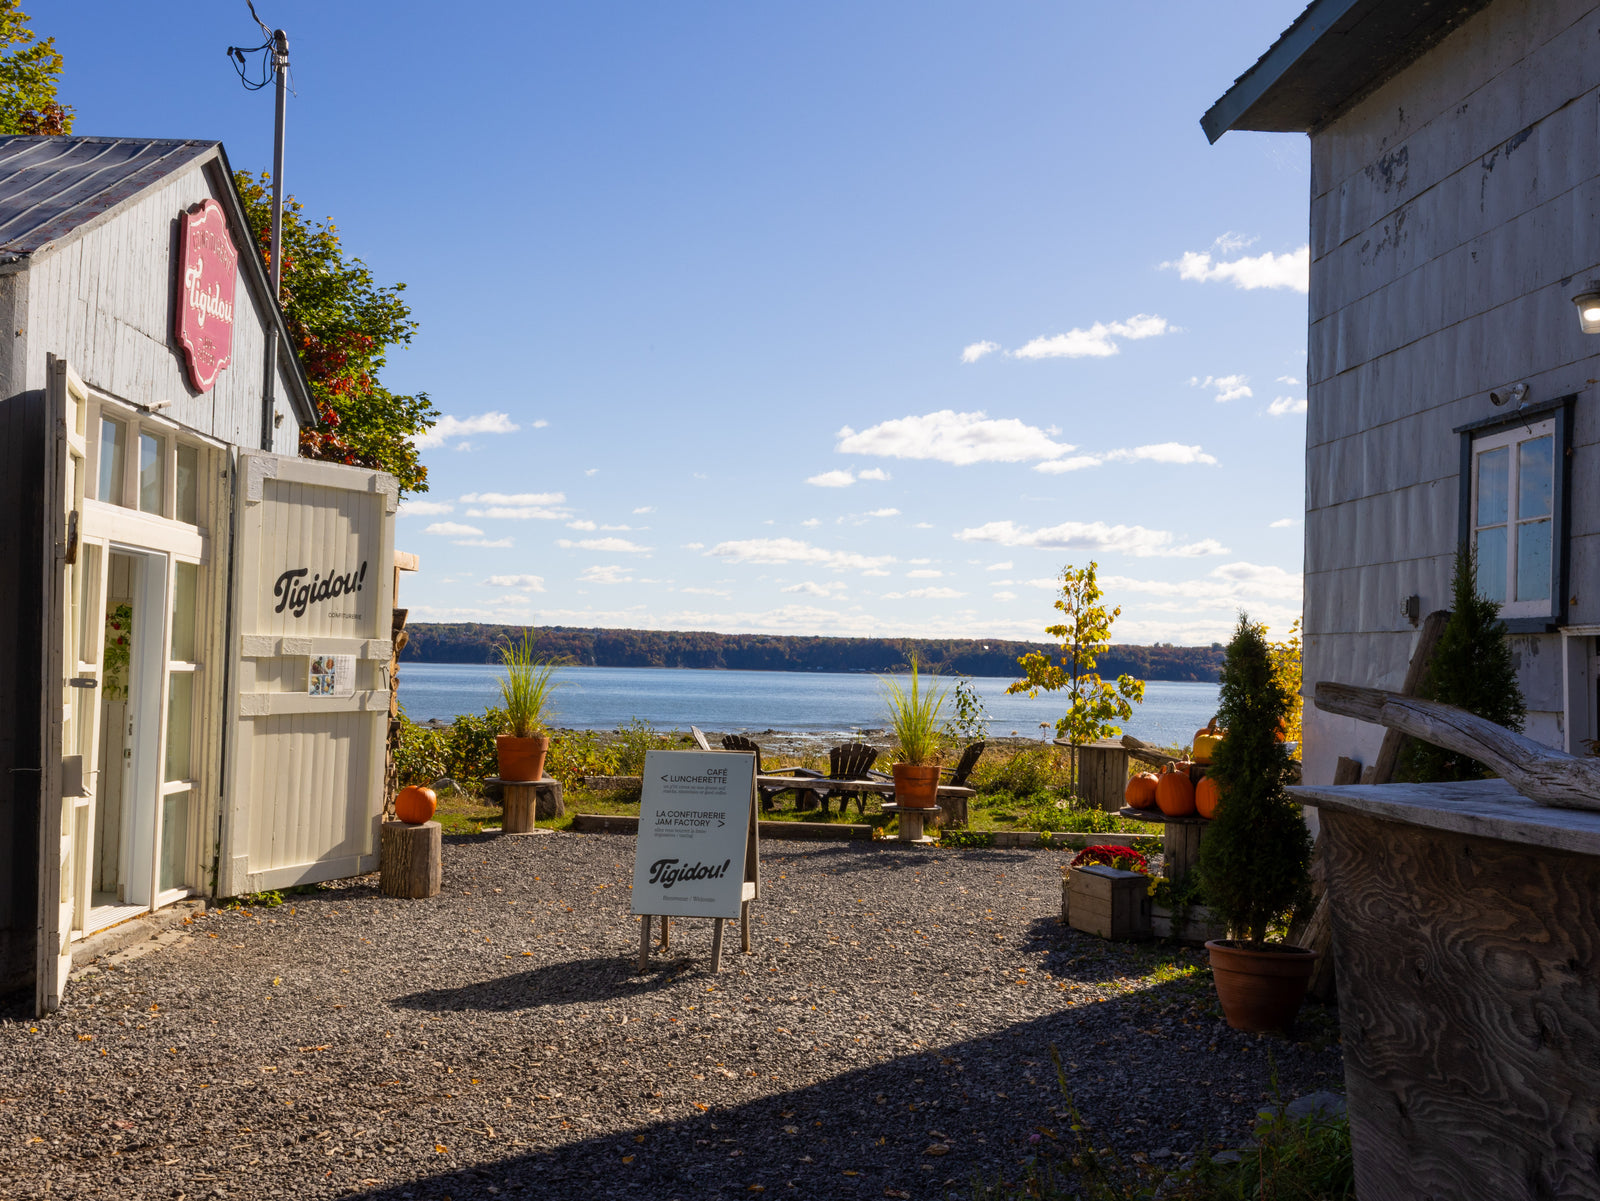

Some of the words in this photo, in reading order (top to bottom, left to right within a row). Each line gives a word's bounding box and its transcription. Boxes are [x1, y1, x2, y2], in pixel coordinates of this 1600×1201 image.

[274, 561, 368, 619] Tigidou!
[706, 768, 728, 777] CAFÉ
[670, 776, 728, 784] LUNCHERETTE
[656, 810, 668, 818] LA
[668, 811, 726, 820] CONFITURERIE
[674, 819, 711, 827] FACTORY
[649, 858, 731, 889] Tigidou!
